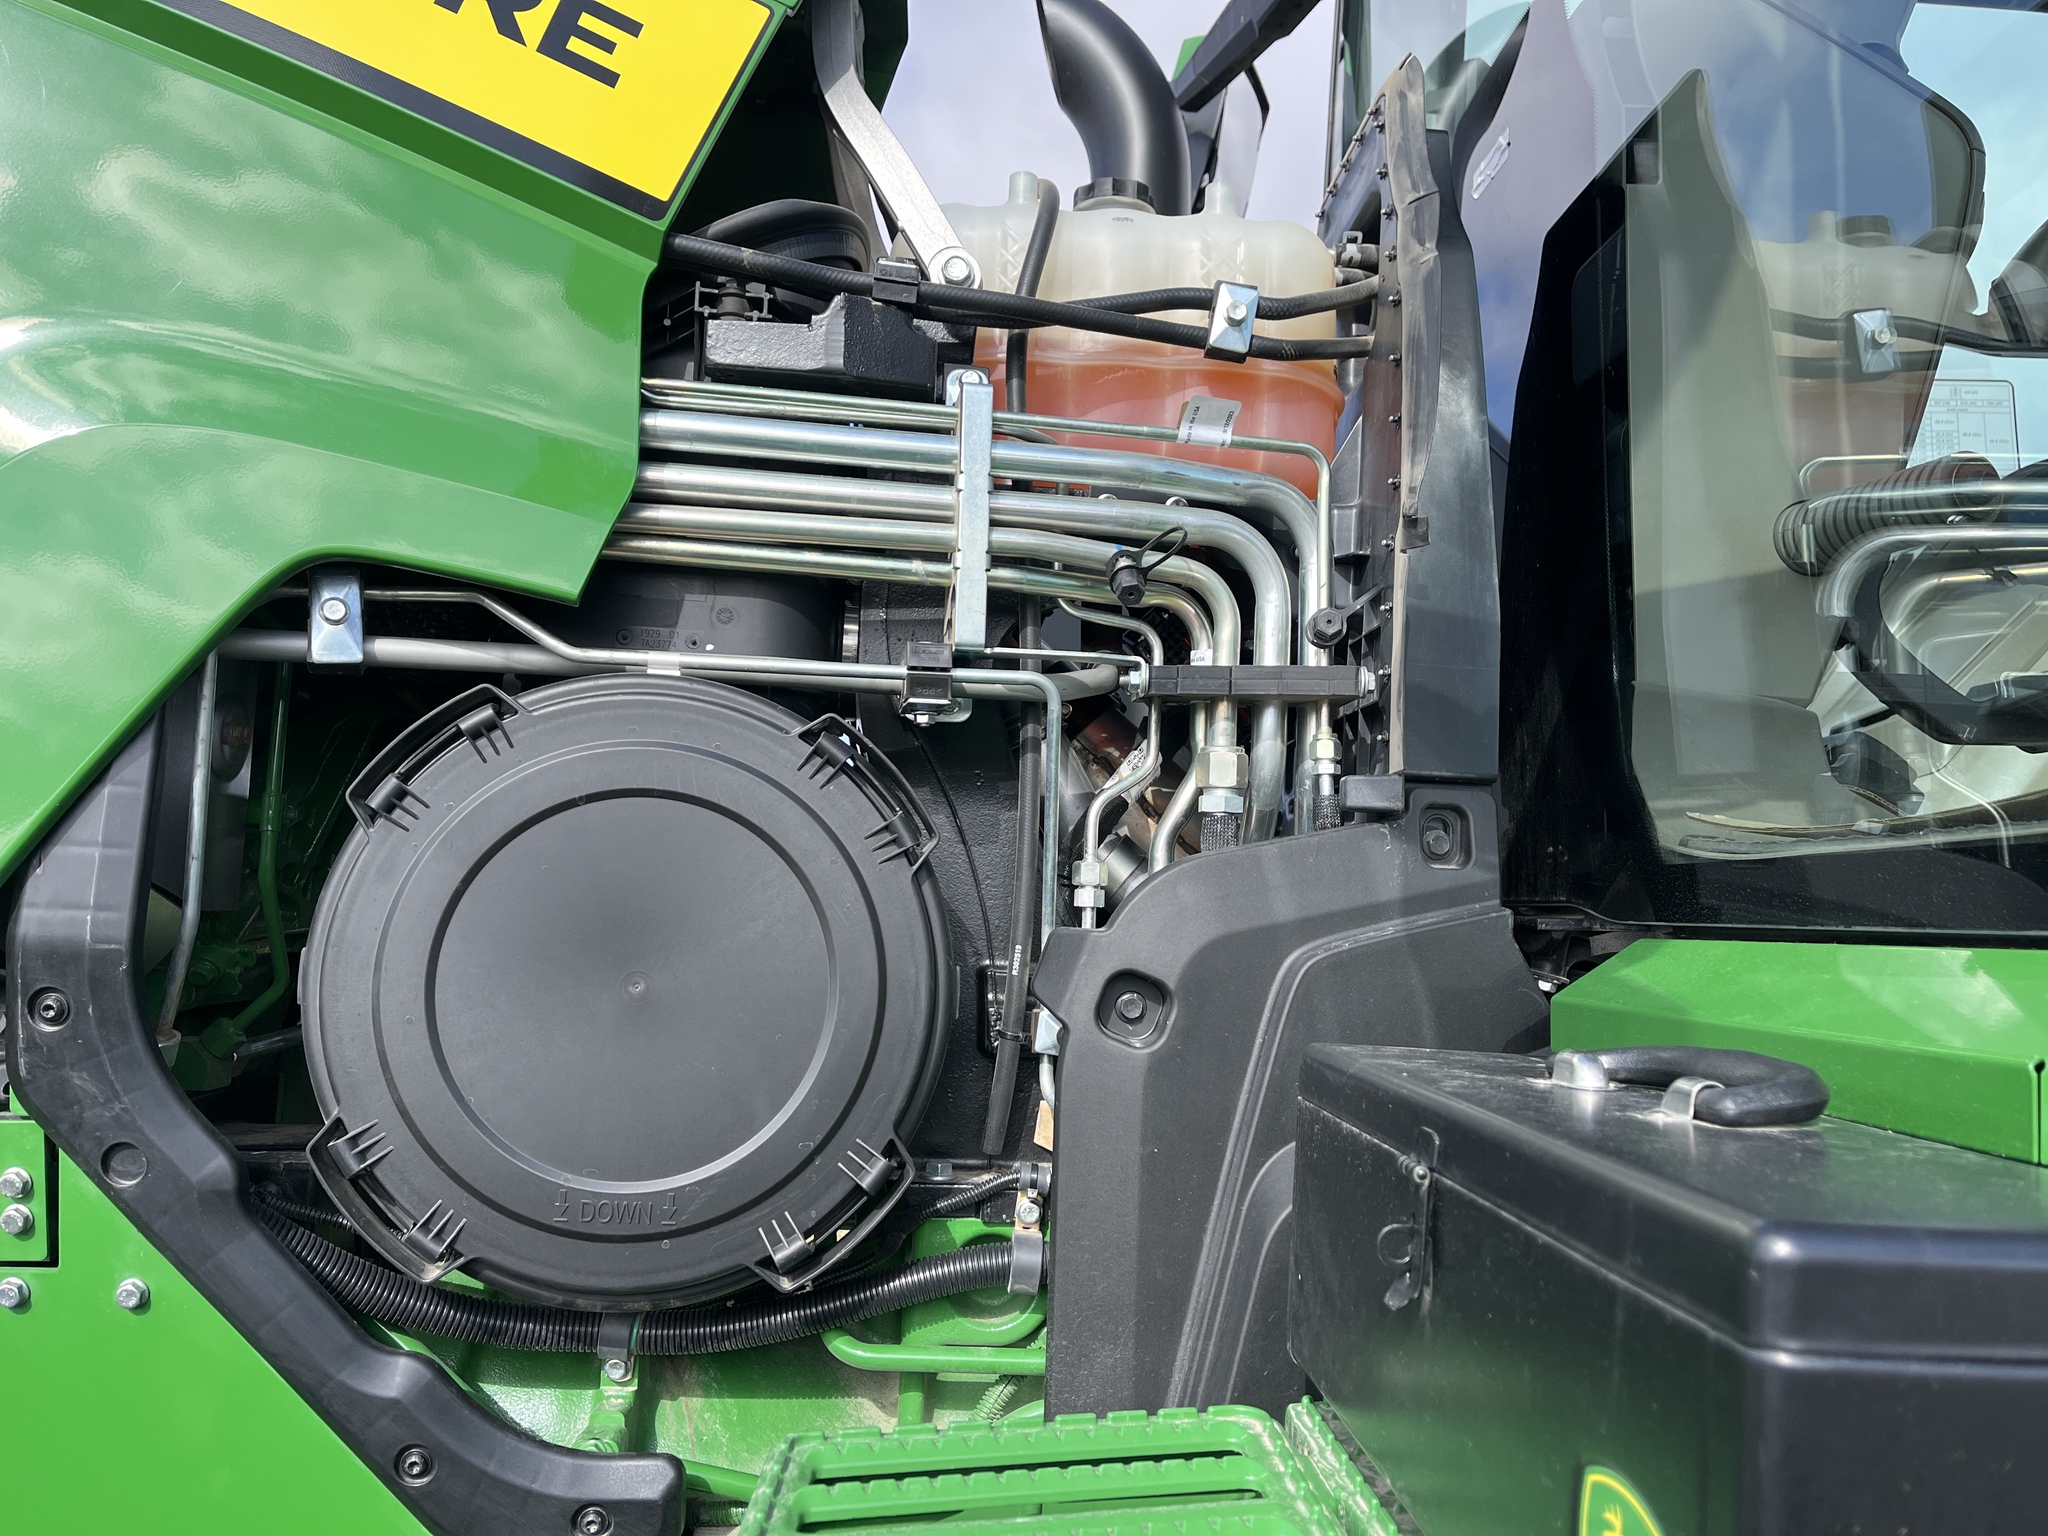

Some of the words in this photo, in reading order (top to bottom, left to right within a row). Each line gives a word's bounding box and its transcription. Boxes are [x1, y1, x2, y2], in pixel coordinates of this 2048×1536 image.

[640, 628, 661, 639] 1929
[640, 638, 678, 650] TA23774
[580, 1199, 653, 1225] DOWN
